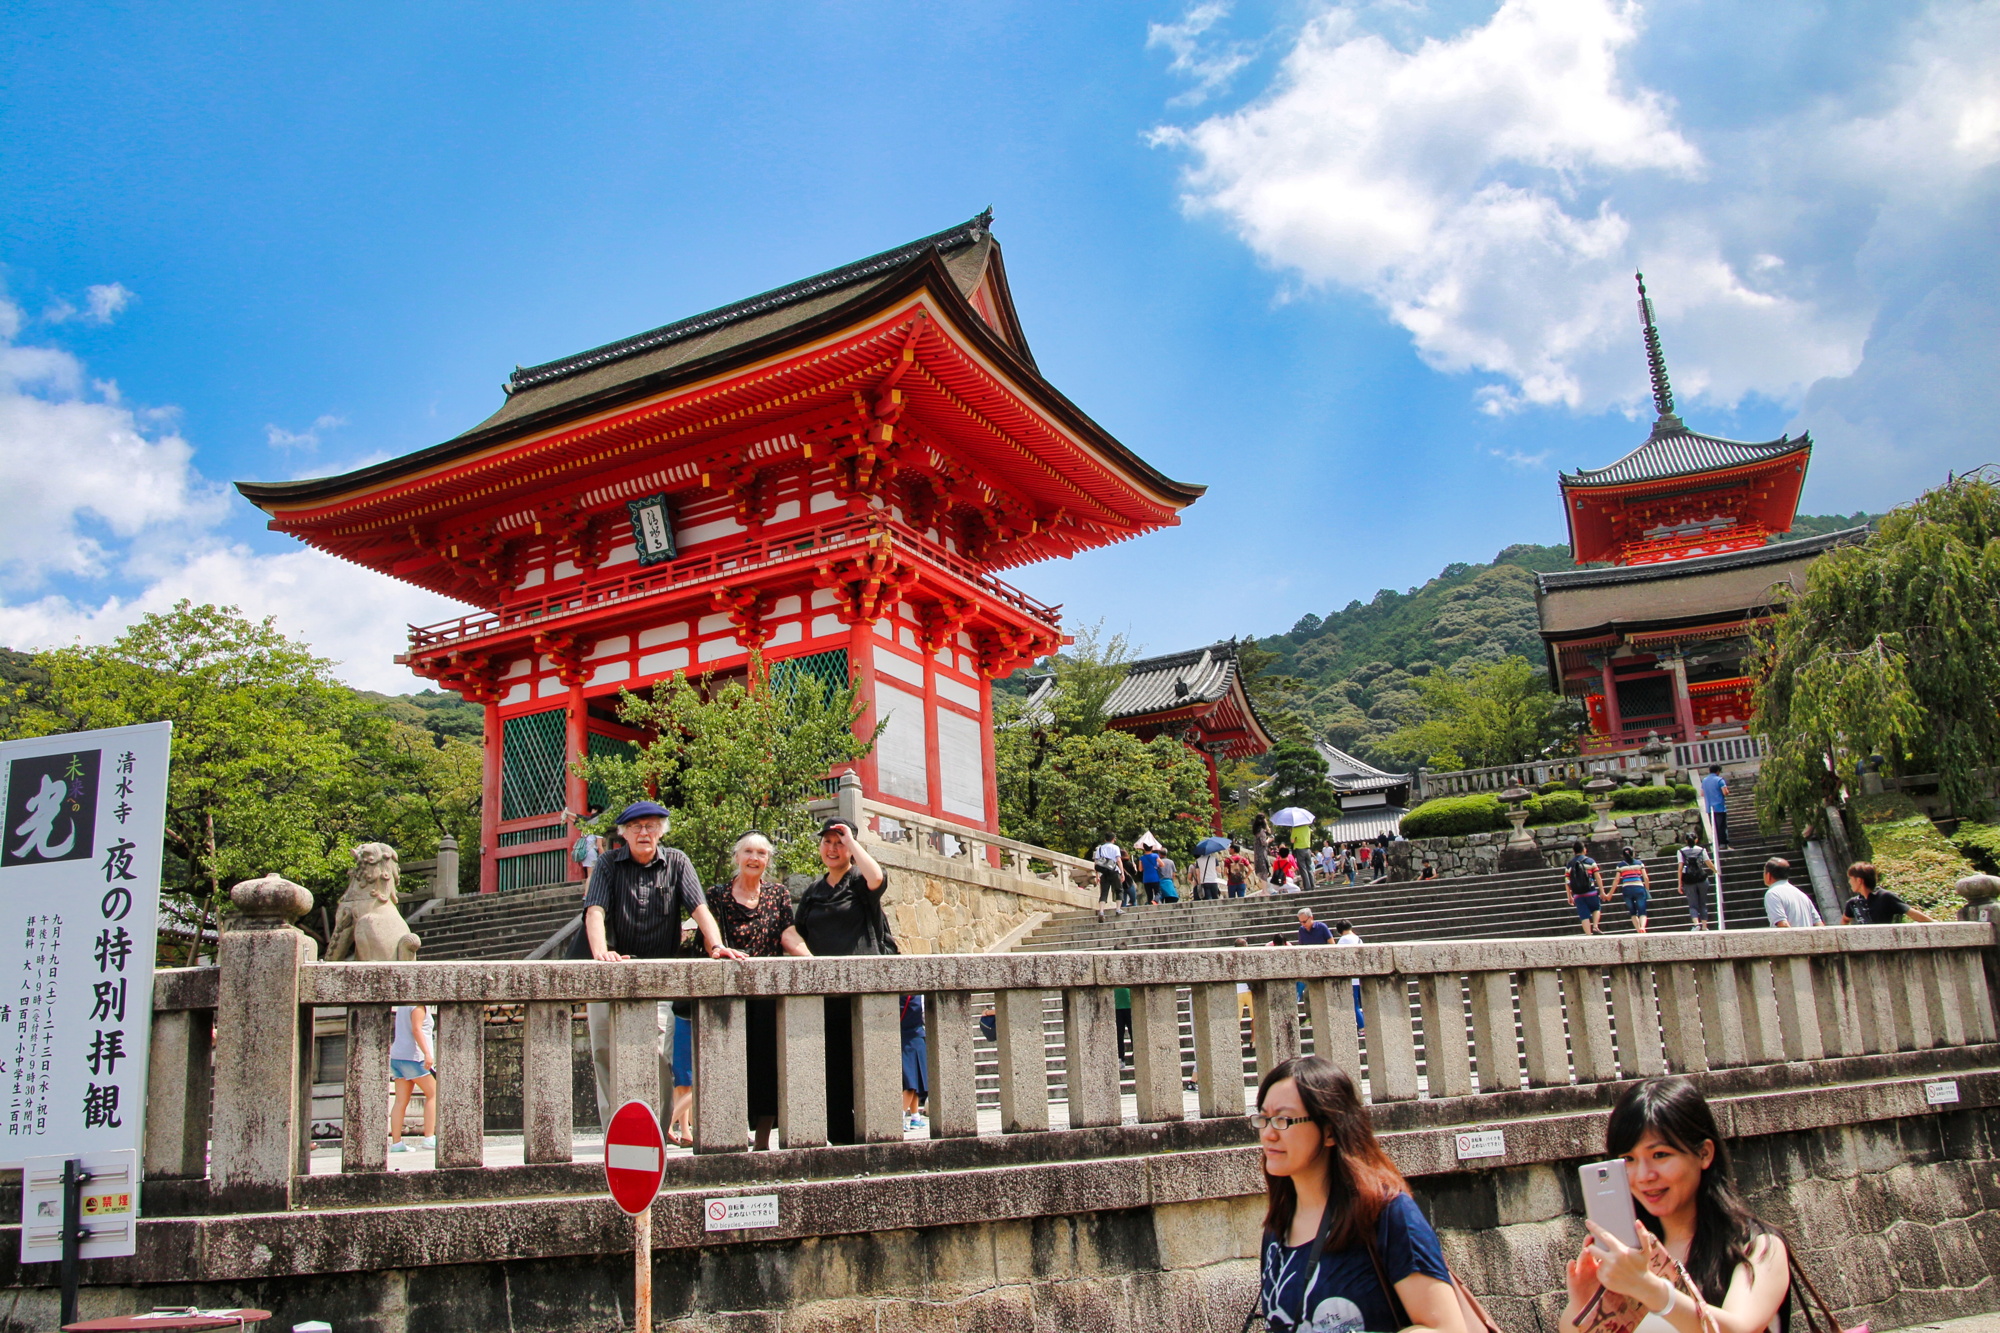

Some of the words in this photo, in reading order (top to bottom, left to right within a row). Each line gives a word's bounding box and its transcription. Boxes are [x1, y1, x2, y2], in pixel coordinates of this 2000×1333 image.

[64, 754, 85, 812] 未来への
[113, 751, 136, 825] 清水寺
[10, 774, 76, 858] 光
[82, 838, 138, 1129] 夜の特別拝観
[102, 1194, 129, 1208] 禁煙
[728, 1209, 774, 1218] 止めないで下さい
[743, 1219, 775, 1227] motorcycles
